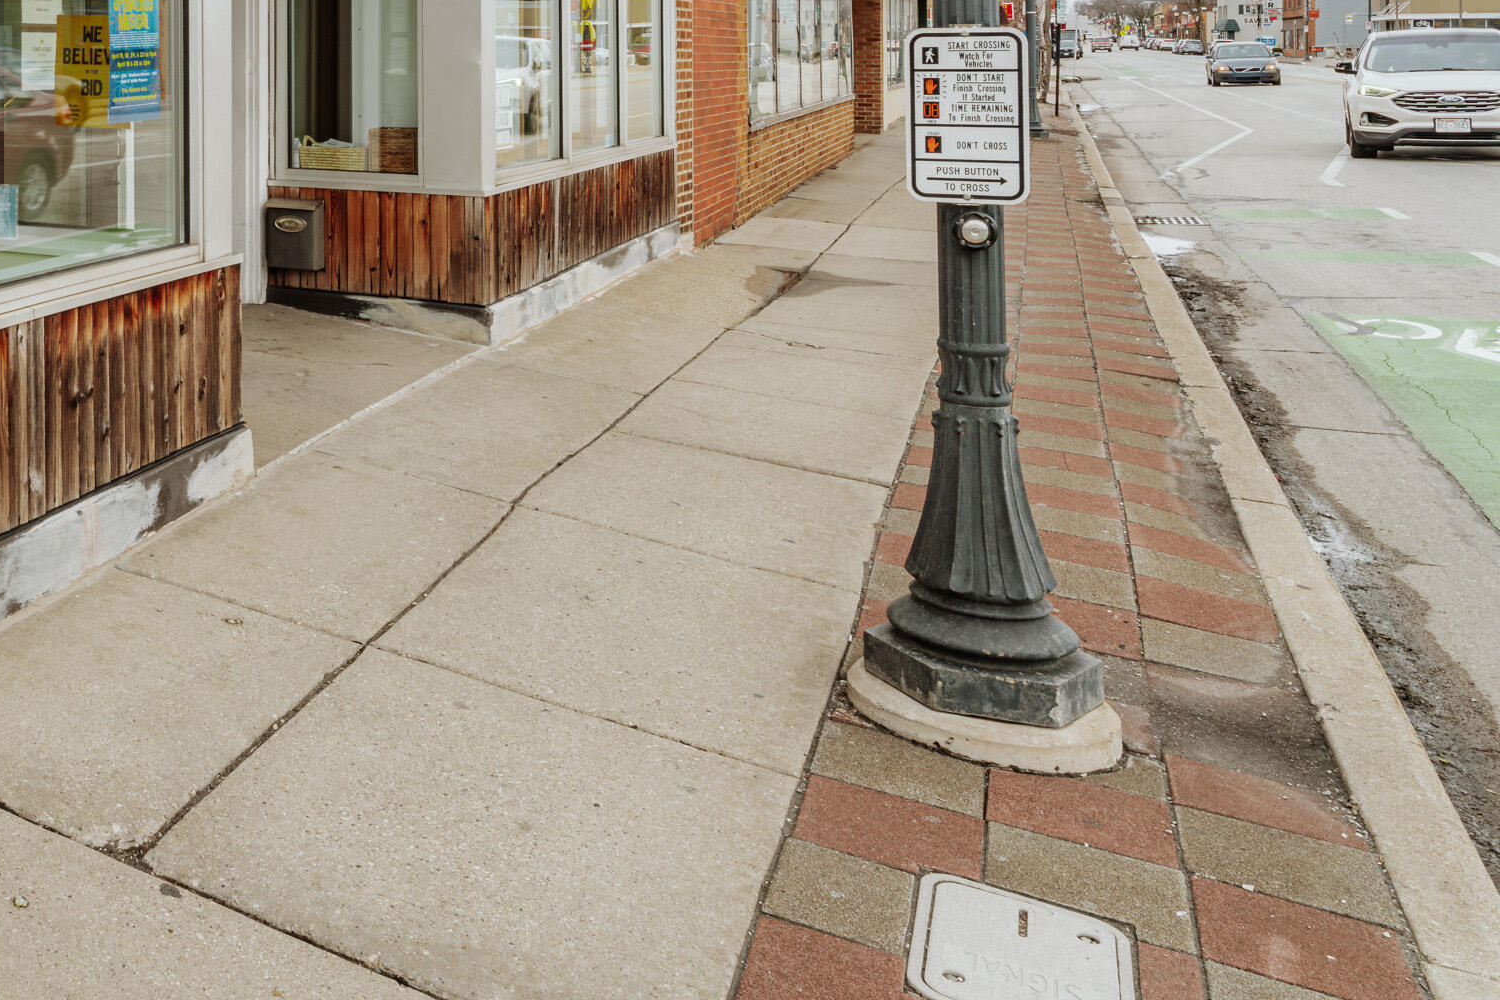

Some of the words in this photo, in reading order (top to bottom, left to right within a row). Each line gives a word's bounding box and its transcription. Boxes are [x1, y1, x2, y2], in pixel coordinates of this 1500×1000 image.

[118, 11, 150, 31] MUSICAL
[82, 25, 103, 43] WE
[948, 41, 969, 50] START
[973, 40, 1011, 49] CROSSING
[959, 52, 980, 60] Watch
[982, 51, 993, 59] For
[964, 60, 993, 68] Vehicles
[956, 73, 978, 82] DON'T
[983, 73, 1005, 82] START
[80, 78, 103, 97] BID
[952, 84, 973, 92] Finish
[977, 84, 1006, 94] Crossing
[971, 93, 996, 102] Started
[923, 102, 940, 118] 08
[951, 104, 968, 113] TIME
[971, 104, 1014, 113] REMAINING
[948, 113, 957, 121] To
[960, 113, 981, 122] Finish
[986, 114, 1015, 124] Crossing
[956, 141, 978, 150] DON'T
[983, 141, 1008, 151] CROSS
[936, 166, 960, 175] PUSH
[964, 167, 999, 177] BUTTON
[945, 182, 956, 191] TO
[960, 183, 990, 193] CROSS
[963, 951, 1086, 1000] SIGNAL
